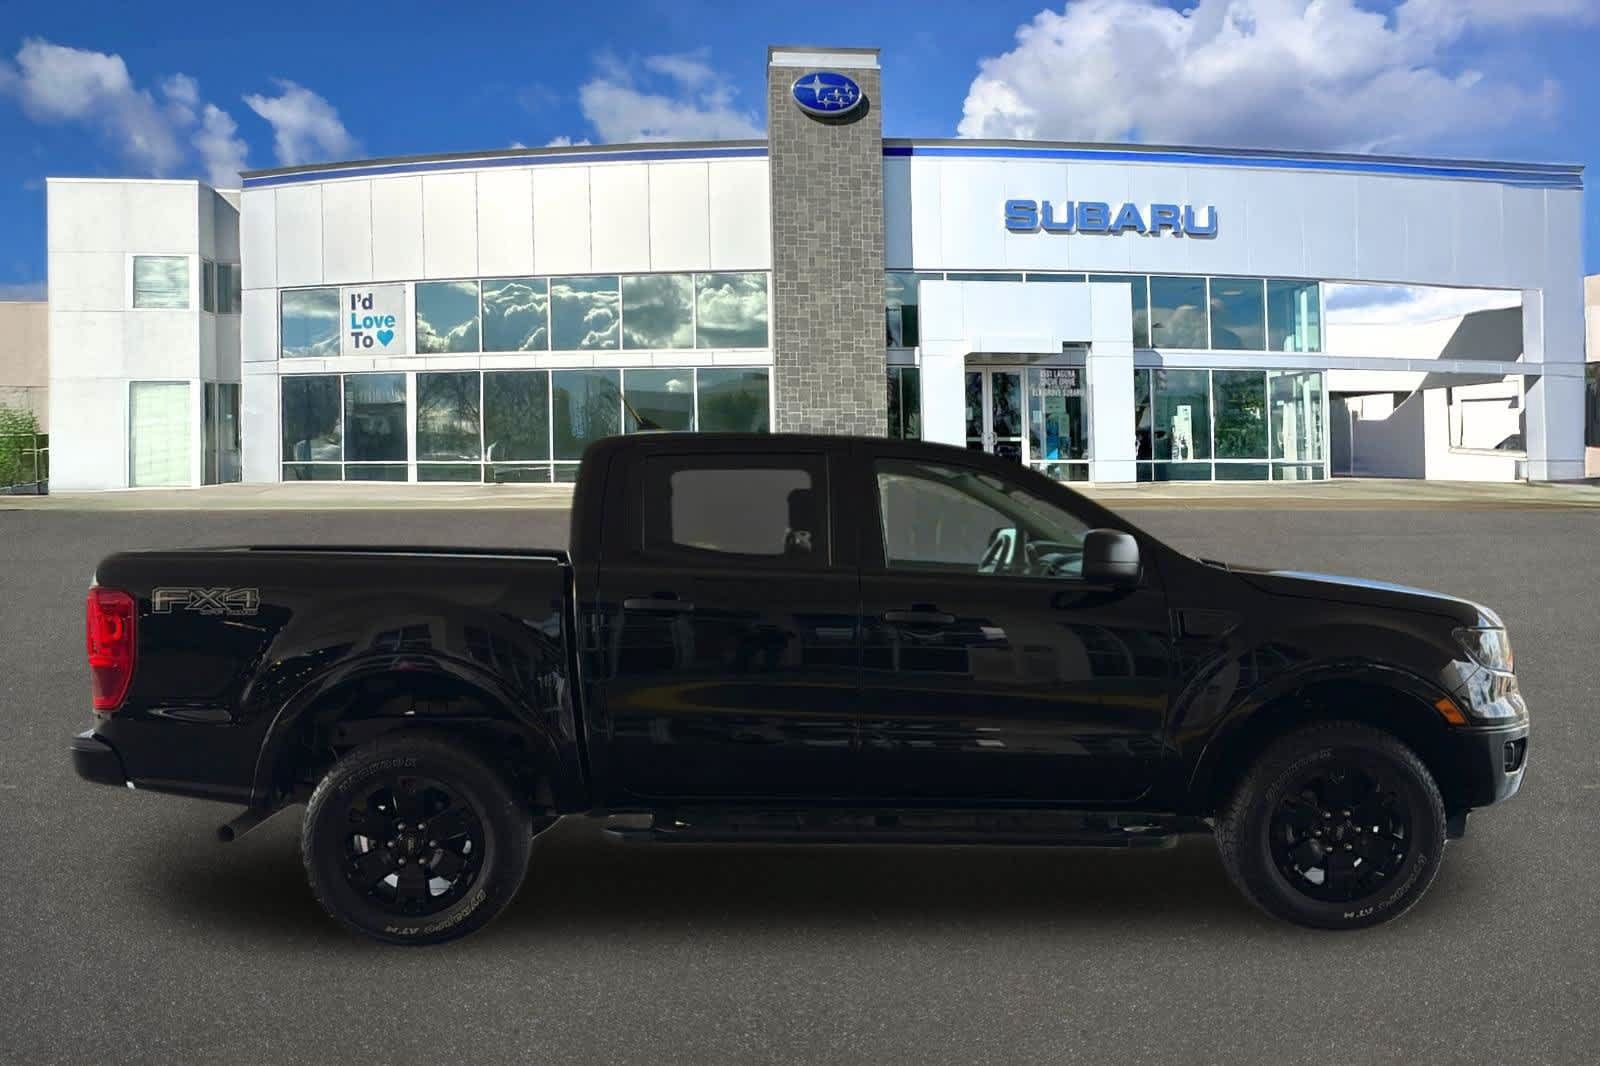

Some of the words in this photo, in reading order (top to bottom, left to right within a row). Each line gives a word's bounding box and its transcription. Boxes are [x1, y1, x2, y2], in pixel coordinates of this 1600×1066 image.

[1005, 199, 1218, 239] SUBARU
[351, 293, 373, 310] I'd
[351, 312, 396, 329] Love
[351, 332, 374, 348] To
[152, 587, 259, 613] FX4
